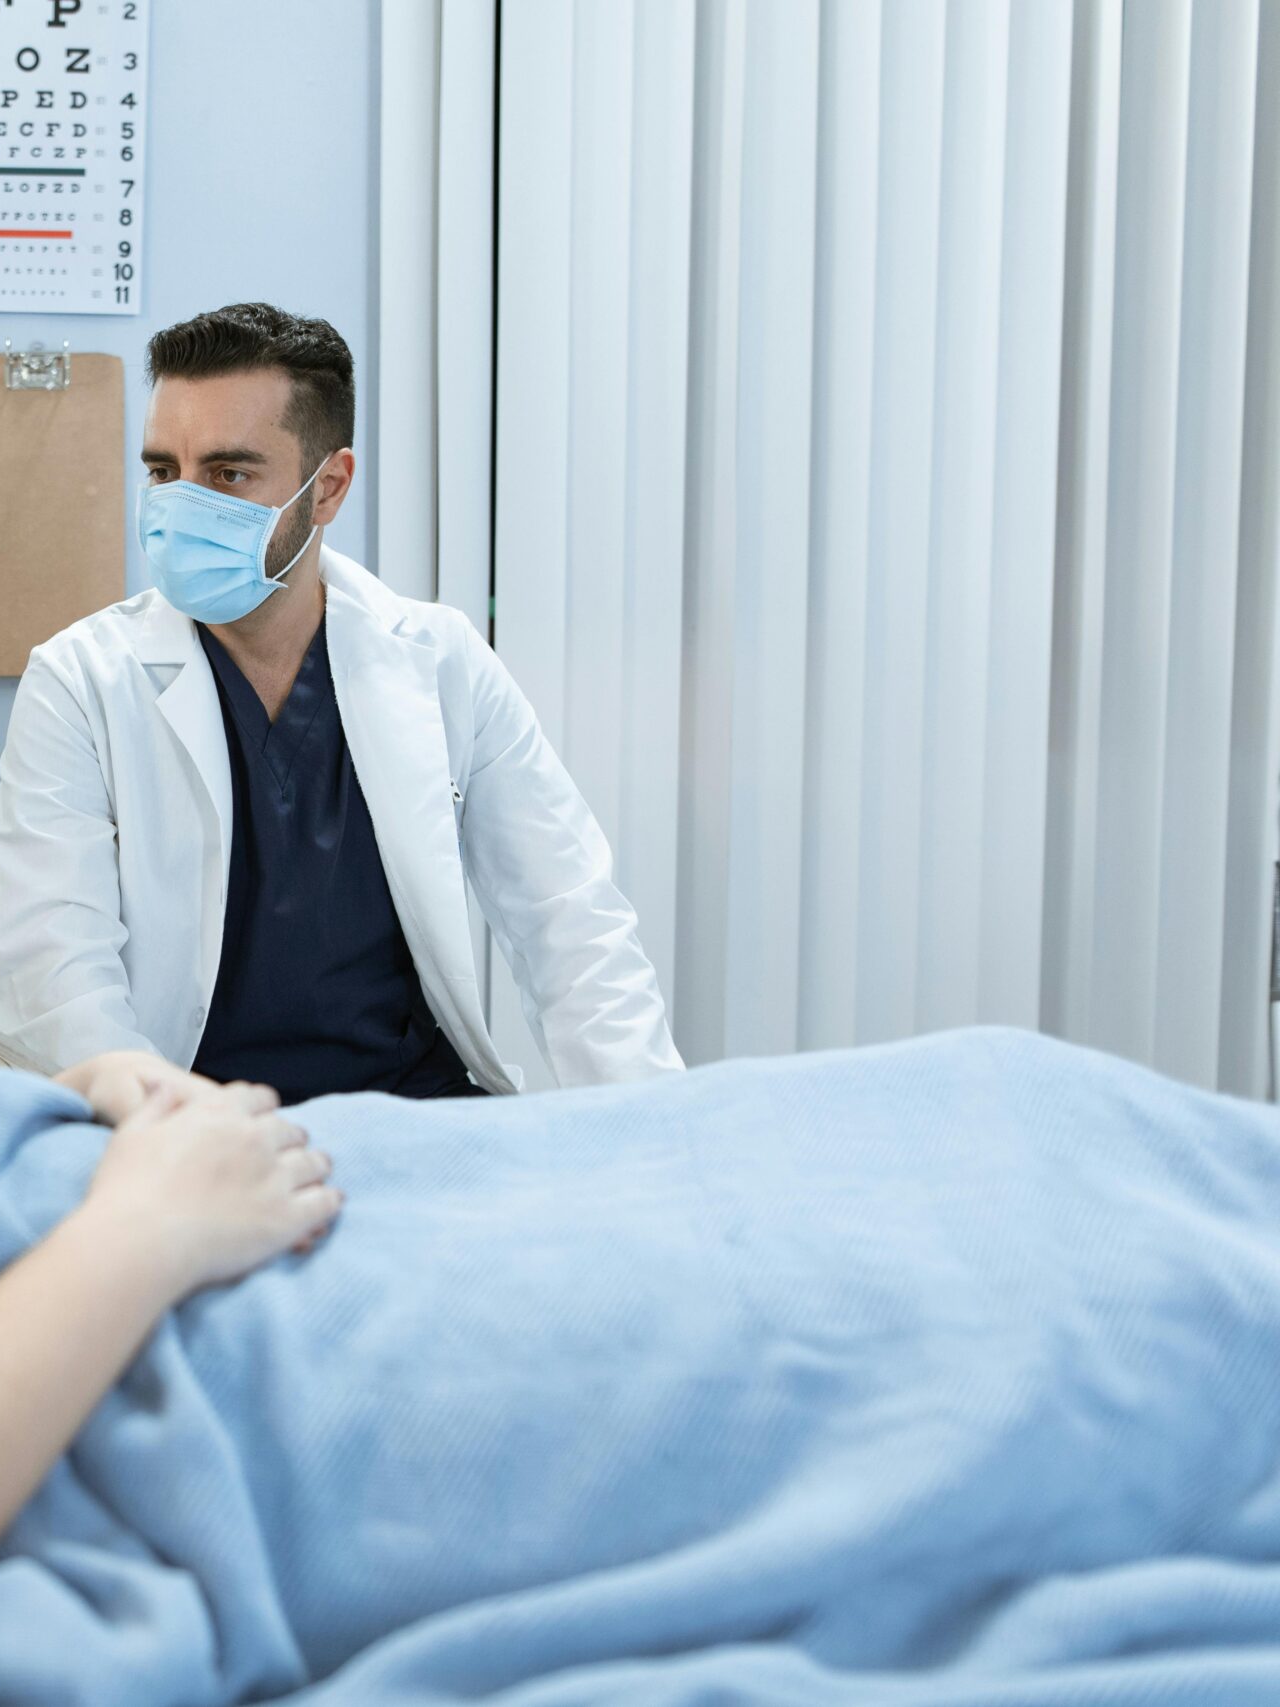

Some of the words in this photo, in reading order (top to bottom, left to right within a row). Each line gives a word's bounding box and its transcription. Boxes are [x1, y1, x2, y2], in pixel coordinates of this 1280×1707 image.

[123, 2, 137, 21] 2
[123, 52, 138, 71] 3
[120, 92, 138, 110] 4
[122, 121, 135, 140] 5
[120, 145, 134, 163] 6
[120, 179, 135, 199] 7
[119, 208, 133, 227] 8
[117, 240, 132, 259] 9
[113, 262, 134, 282] 10
[114, 285, 130, 304] 11
